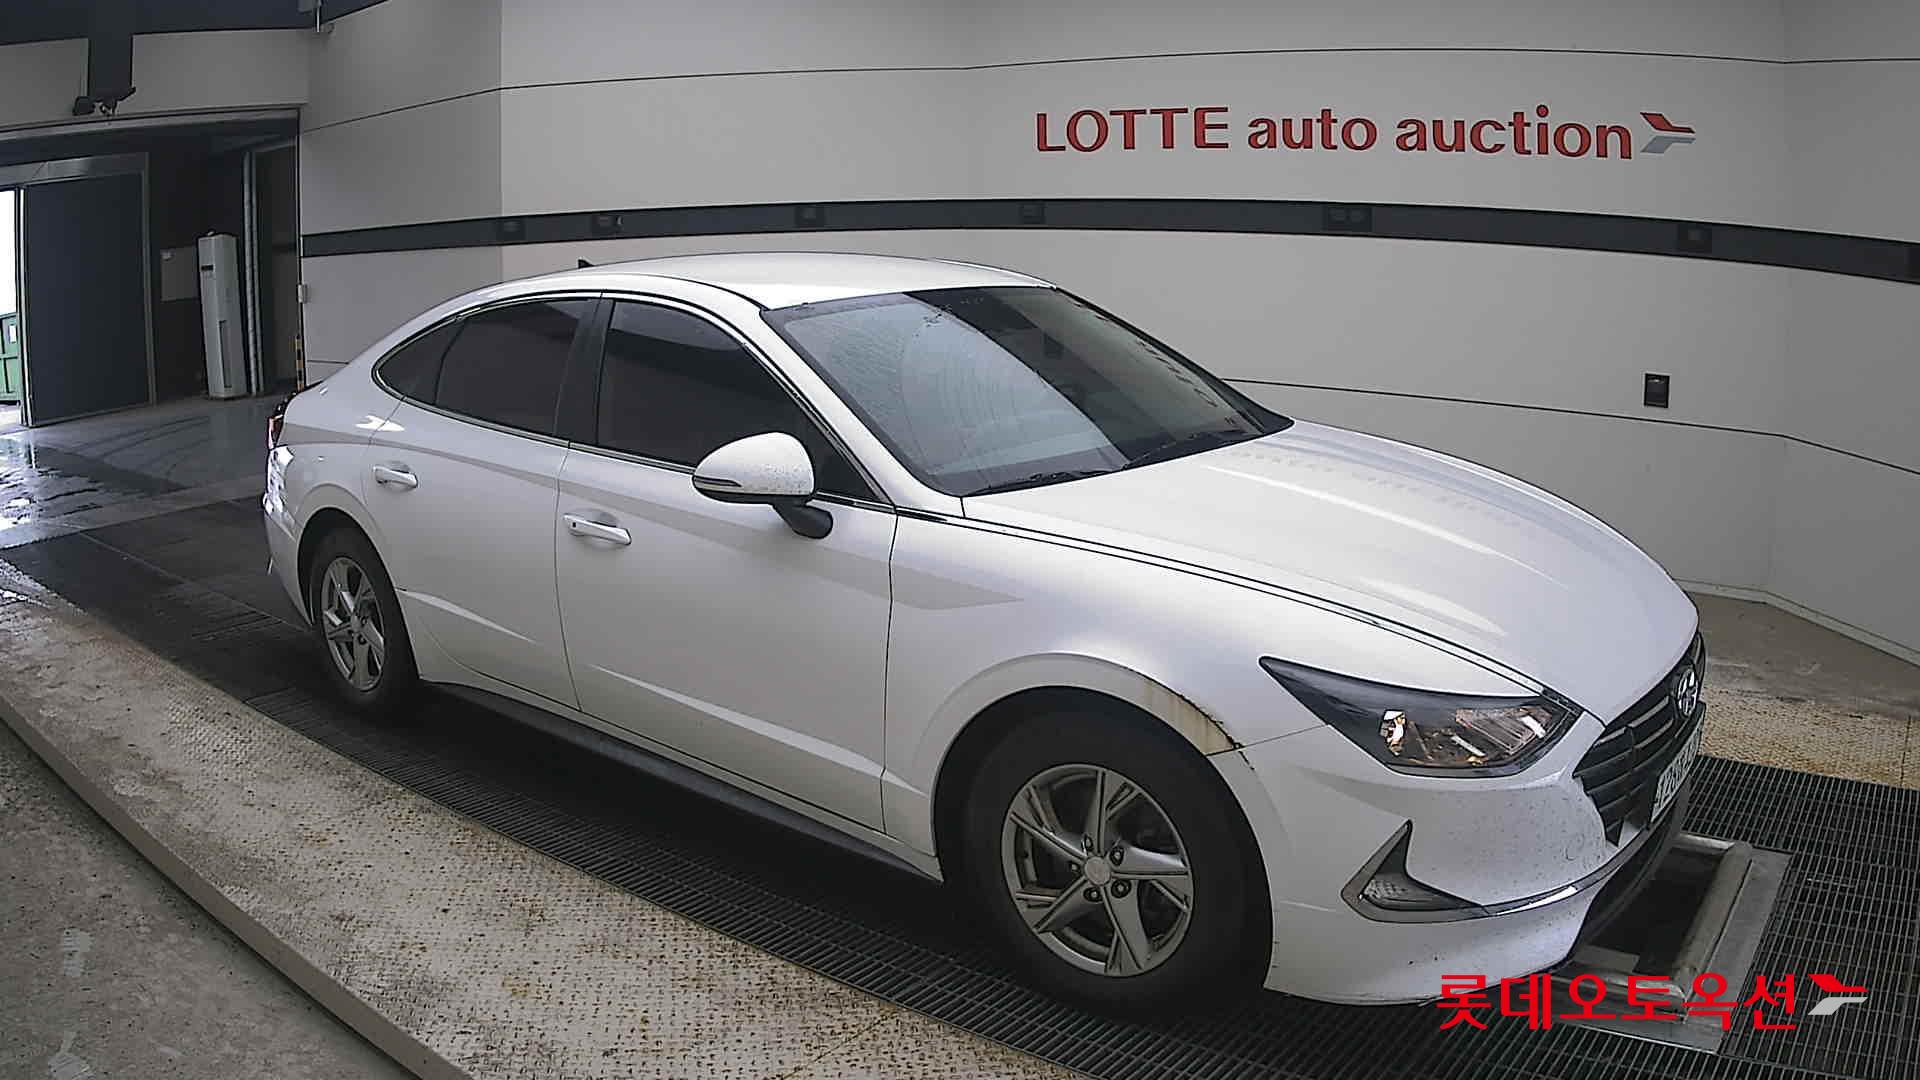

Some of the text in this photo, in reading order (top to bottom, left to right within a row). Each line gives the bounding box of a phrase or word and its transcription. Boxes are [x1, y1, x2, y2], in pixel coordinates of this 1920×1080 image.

[1036, 105, 1633, 159] LOTTE auto auction
